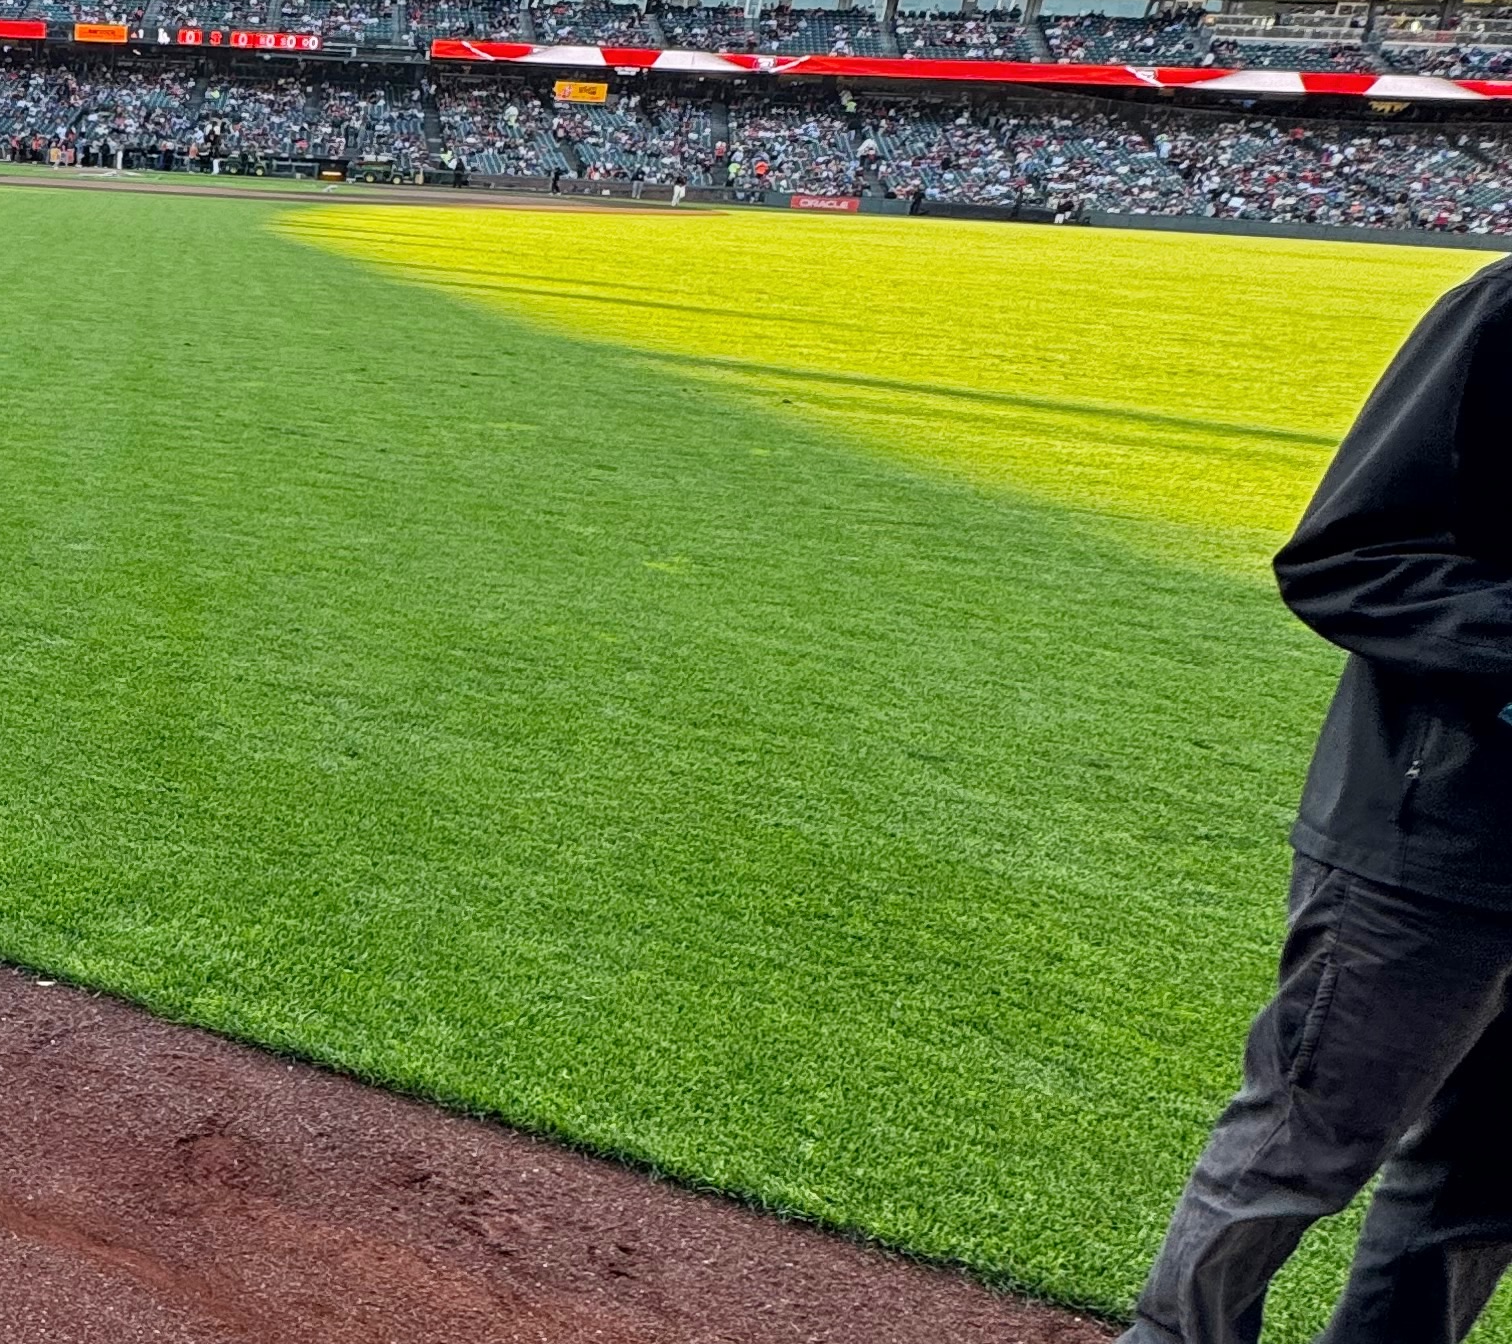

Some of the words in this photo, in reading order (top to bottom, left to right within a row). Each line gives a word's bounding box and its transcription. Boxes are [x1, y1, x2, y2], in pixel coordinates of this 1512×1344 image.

[185, 30, 195, 45] 0
[238, 32, 248, 47] 0
[799, 198, 849, 210] ORACLE
